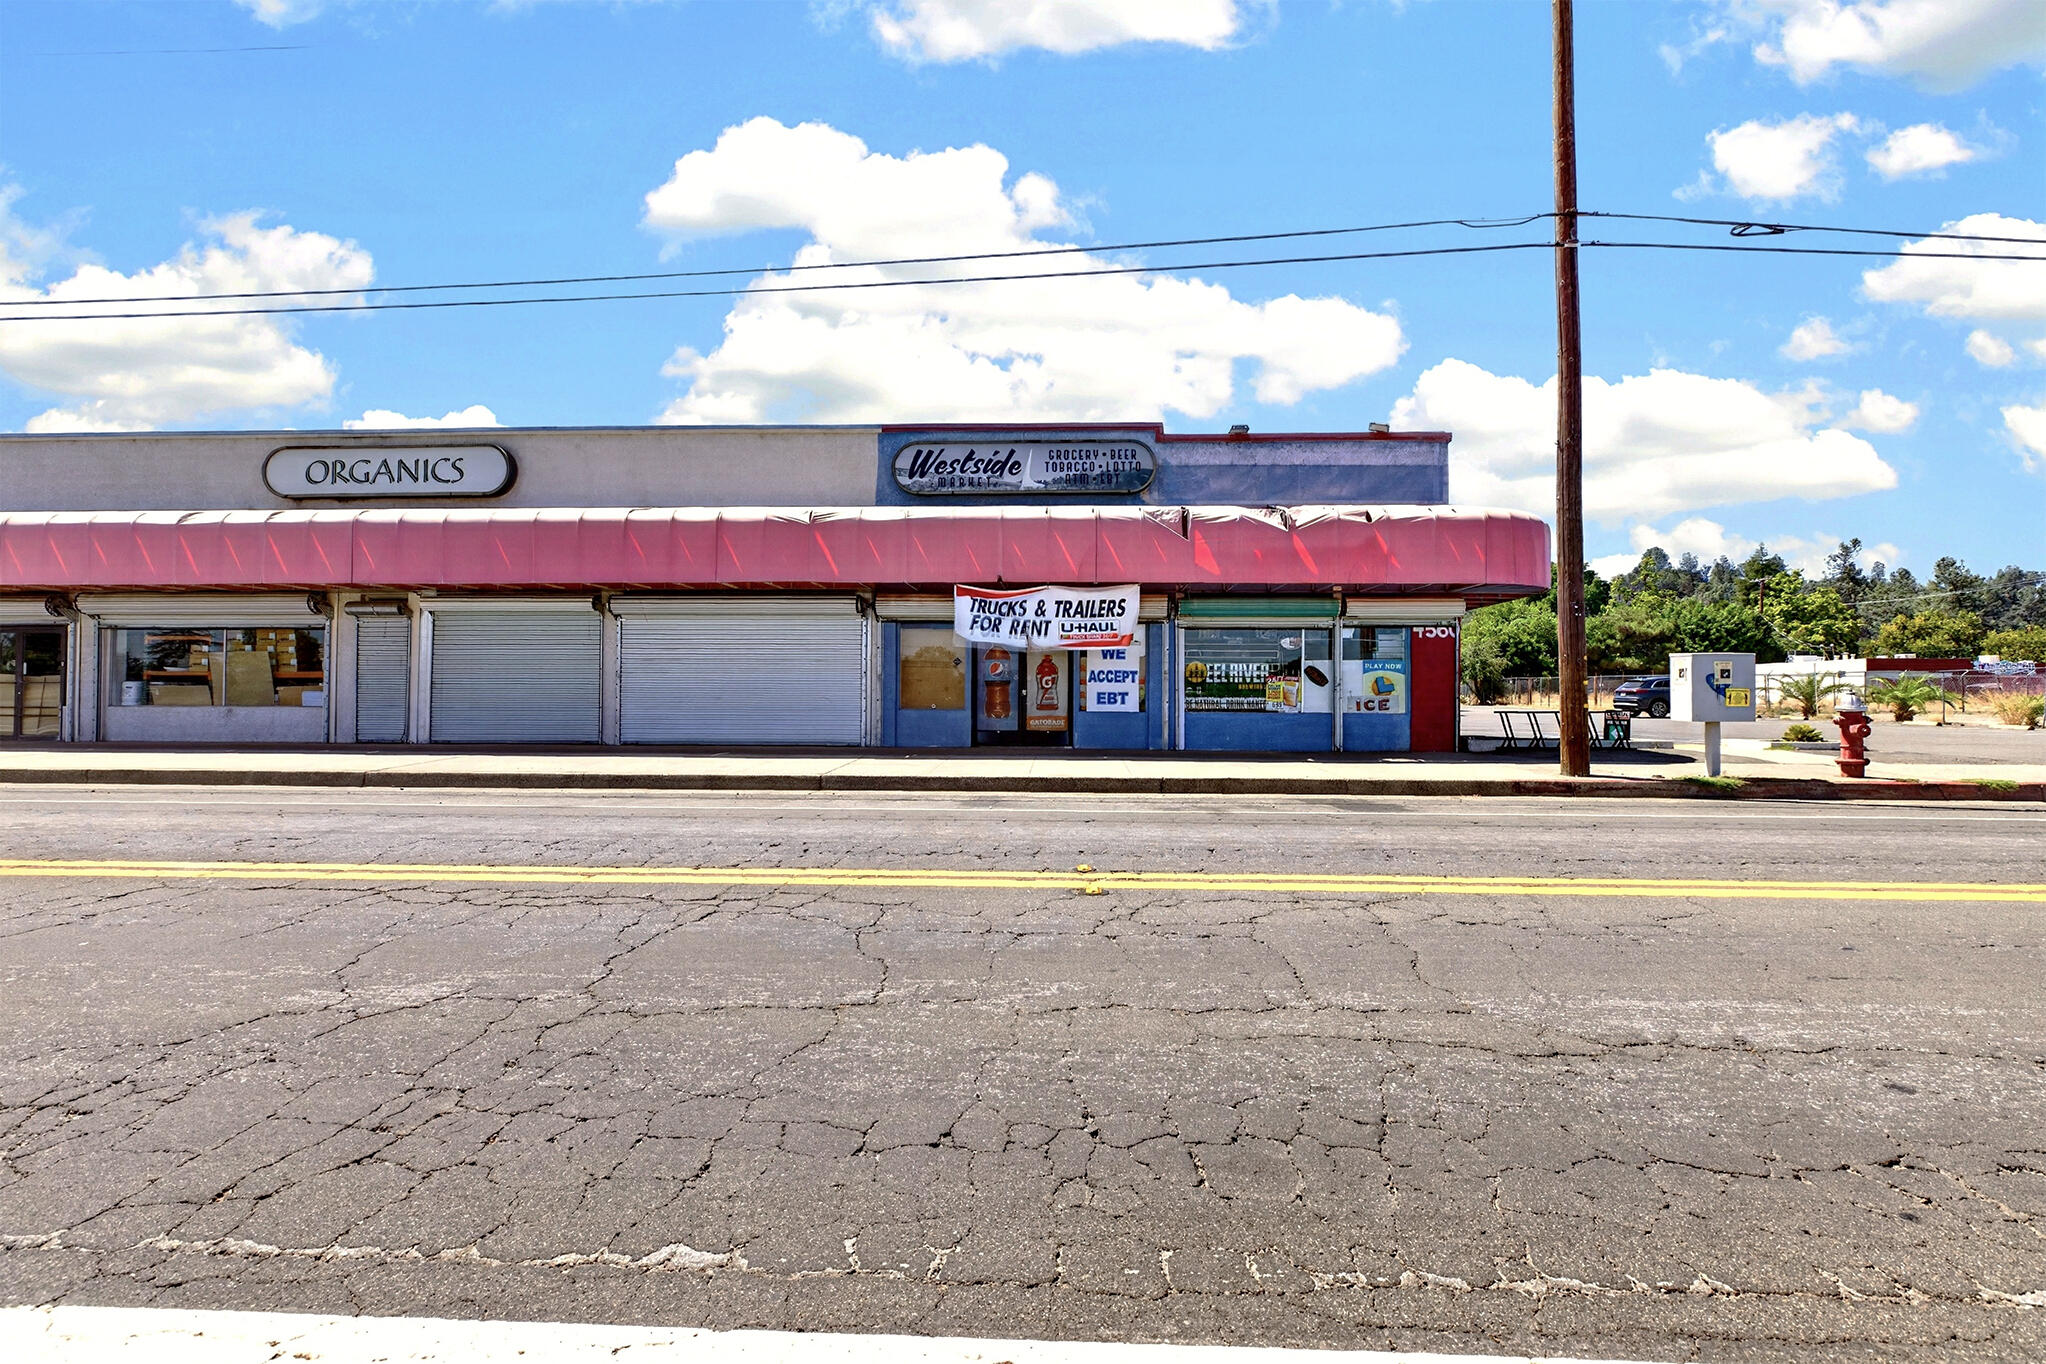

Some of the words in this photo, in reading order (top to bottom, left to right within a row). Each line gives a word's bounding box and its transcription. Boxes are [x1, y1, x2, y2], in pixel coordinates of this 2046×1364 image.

[1048, 449, 1099, 461] GROCERY
[1110, 449, 1137, 460] BEER
[908, 448, 1022, 480] Westside
[1044, 461, 1095, 473] TOBACCO
[1106, 461, 1142, 472] LOTTO
[305, 458, 464, 485] ORGANICS
[937, 476, 991, 488] MARKET
[1065, 473, 1090, 485] ATM
[1100, 473, 1121, 484] EBT
[970, 597, 1028, 617] TRUCKS
[1034, 599, 1047, 617] &
[1054, 598, 1127, 618] TRAILERS
[969, 614, 1002, 633] FOR
[1009, 617, 1052, 637] RENT
[1061, 622, 1118, 632] U-HAUL
[1101, 649, 1127, 660] WE
[1088, 669, 1138, 683] ACCEPT
[1206, 663, 1228, 683] EEL
[1230, 663, 1269, 683] RIVER
[1096, 691, 1129, 705] EBT
[1356, 699, 1390, 711] ICE
